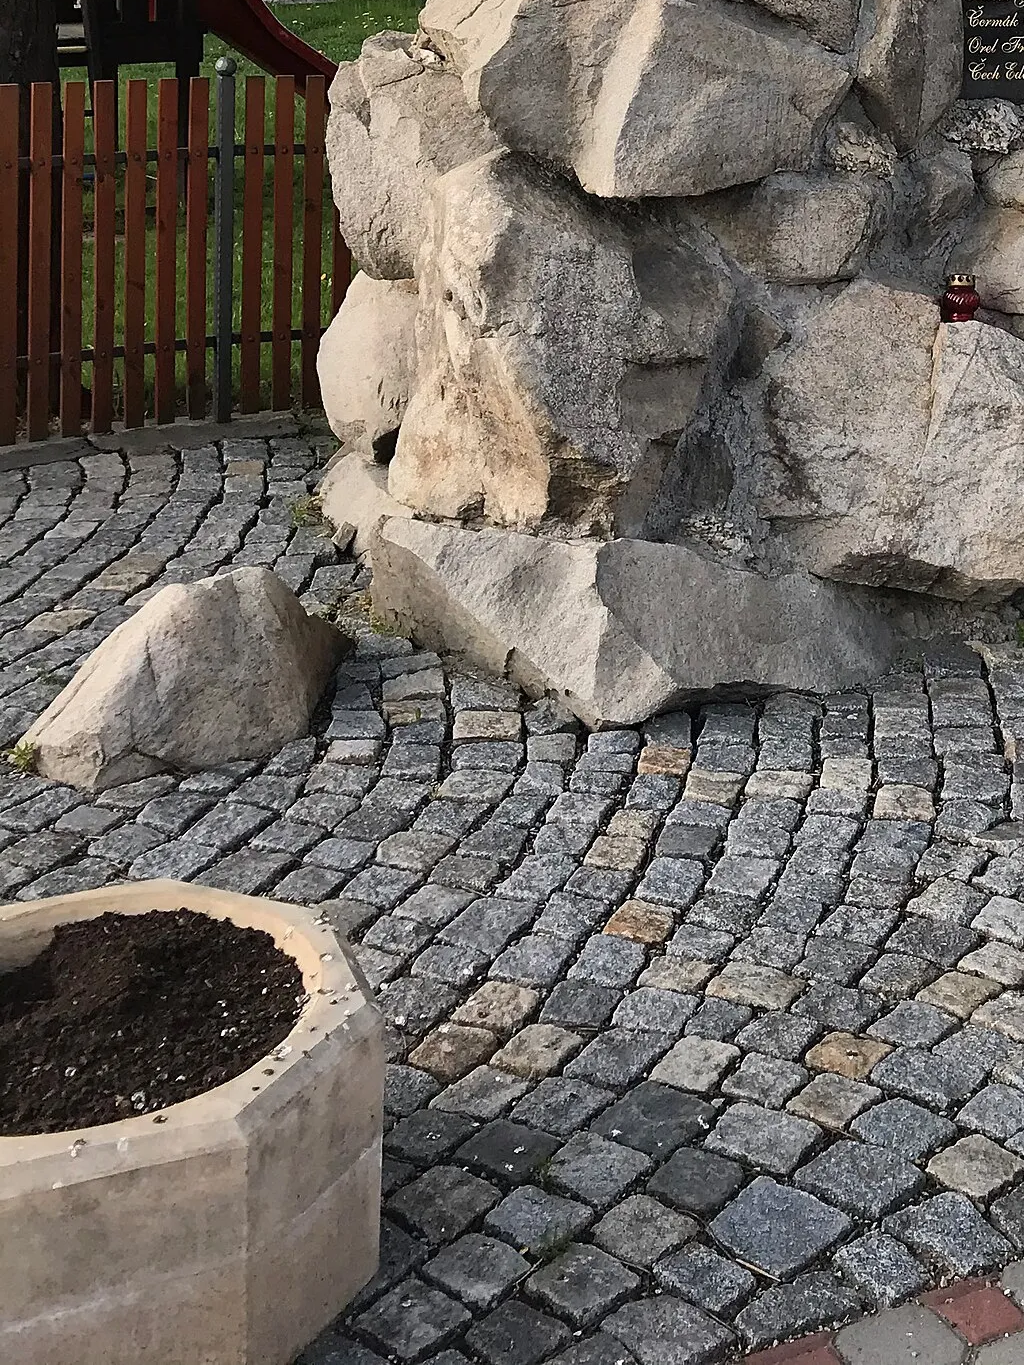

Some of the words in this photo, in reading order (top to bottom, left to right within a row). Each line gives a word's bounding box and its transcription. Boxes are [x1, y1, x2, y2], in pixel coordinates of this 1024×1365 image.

[965, 5, 1019, 28] Čermák
[967, 36, 999, 54] Orel
[968, 58, 1001, 81] Čech
